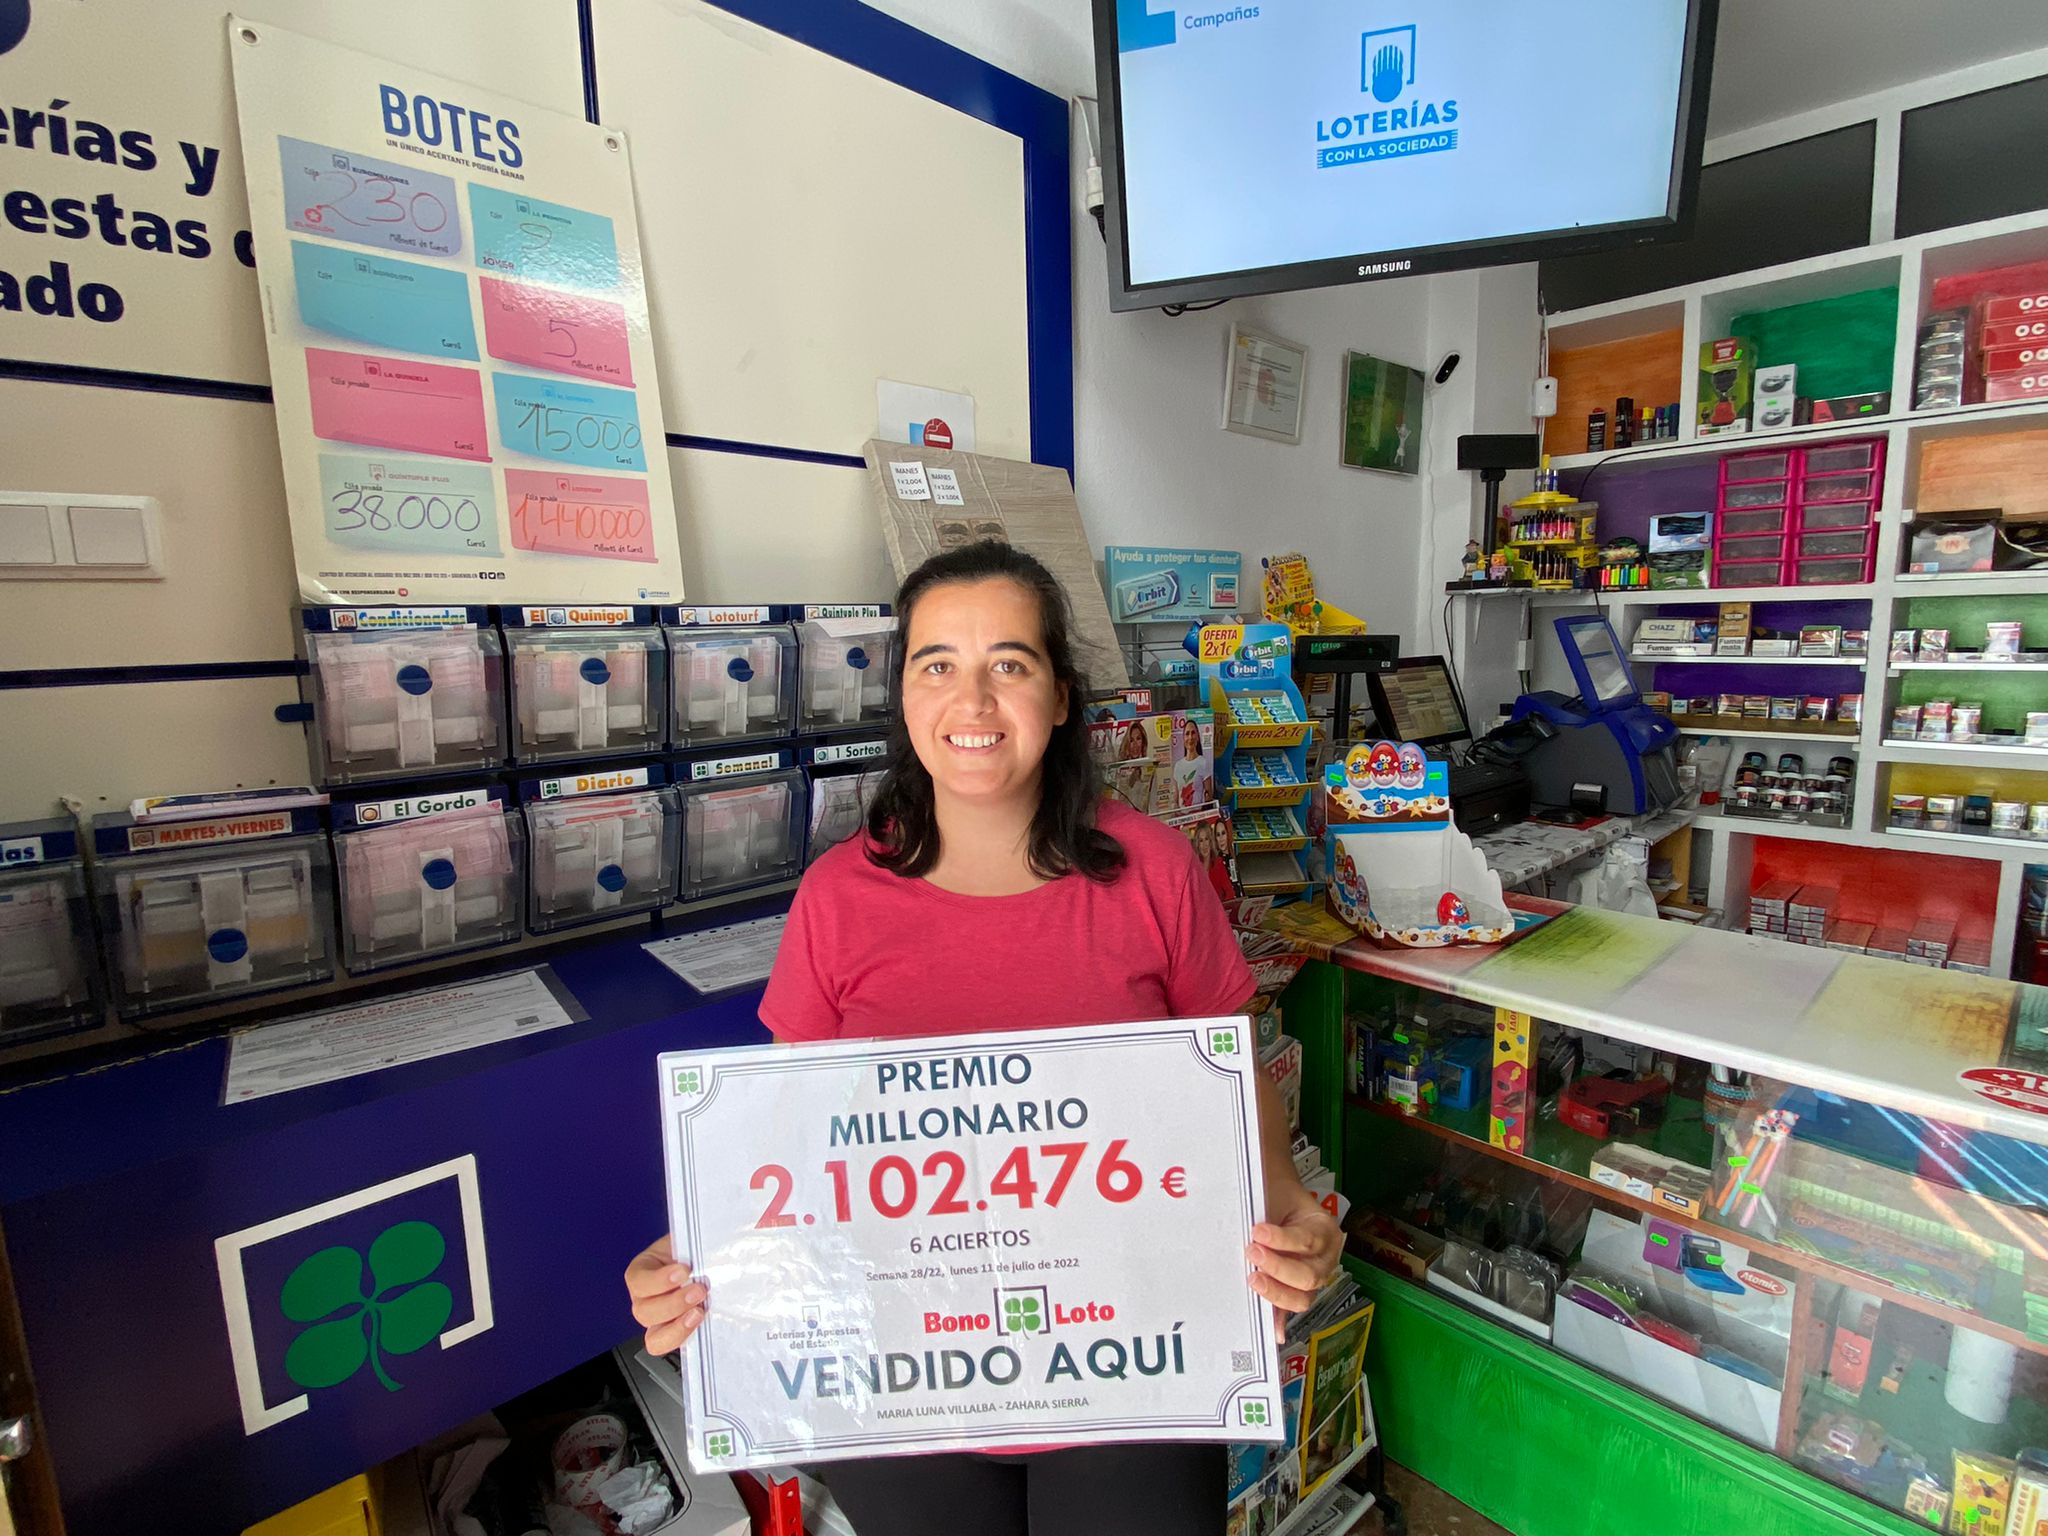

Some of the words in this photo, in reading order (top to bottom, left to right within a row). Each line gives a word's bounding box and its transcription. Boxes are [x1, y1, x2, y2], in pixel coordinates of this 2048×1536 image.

[1183, 5, 1260, 31] Campañas
[379, 83, 523, 168] BOTES
[1316, 100, 1459, 142] LOTERÍAS
[0, 98, 157, 170] rías
[178, 141, 220, 197] y
[1325, 147, 1356, 164] CON
[1358, 146, 1376, 160] LA
[1378, 135, 1449, 157] SOCIEDAD
[386, 139, 398, 148] UN
[400, 141, 425, 155] ÚNICO
[426, 147, 470, 167] ACERTANTE
[472, 160, 499, 174] PODRÍA
[500, 169, 525, 181] GANAR
[313, 171, 447, 232] 230
[1358, 260, 1411, 276] SAMSUNG
[544, 320, 579, 357] 5
[1114, 549, 1144, 564] Ayuda
[1146, 553, 1152, 561] a
[1154, 552, 1191, 566] proteger
[1193, 553, 1207, 563] tus
[1137, 585, 1167, 602] Orbit
[359, 610, 466, 627] Condicionadas
[530, 610, 545, 622] El
[569, 610, 629, 624] Quinigol
[708, 609, 759, 623] Lototurf
[822, 607, 860, 619] Quintuple
[862, 608, 877, 618] Plus
[1203, 629, 1238, 641] OFERTA
[1718, 638, 1745, 646] Fumar
[1241, 643, 1272, 660] Orbit
[1647, 643, 1672, 653] Fumar
[1226, 661, 1258, 678] Orbit
[835, 747, 840, 758] 1
[846, 745, 882, 758] Sorteo
[716, 757, 773, 775] Semanal
[576, 772, 634, 792] Diario
[394, 802, 410, 817] El
[416, 795, 477, 814] Gordo
[159, 818, 285, 844] MARTES+VIERNES
[877, 1053, 1032, 1095] PREMIO
[829, 1098, 1089, 1148] MILLONARIO
[749, 1139, 1143, 1229] 2.102.476
[1159, 1166, 1188, 1199] €
[910, 1237, 922, 1254] 6
[928, 1229, 1031, 1253] ACIERTOS
[866, 1268, 908, 1282] Semana
[910, 1266, 945, 1281] 28/22,
[950, 1265, 978, 1277] lunes
[981, 1263, 993, 1274] 11
[996, 1261, 1009, 1273] de
[1011, 1260, 1035, 1275] julio
[1038, 1259, 1051, 1271] de
[1054, 1257, 1080, 1270] 2022
[1740, 1271, 1778, 1292] Atomic
[924, 1312, 990, 1335] Bono
[1054, 1302, 1115, 1326] Loto
[790, 1339, 808, 1350] del
[807, 1331, 814, 1341] y
[771, 1344, 1022, 1401] VENDIDO
[1044, 1321, 1187, 1385] AQUÍ
[877, 1408, 913, 1420] MARIA
[915, 1406, 945, 1418] LUNA
[947, 1403, 997, 1416] VILLALBA
[1005, 1400, 1049, 1412] ZAHARA
[1051, 1397, 1089, 1409] SIERRA
